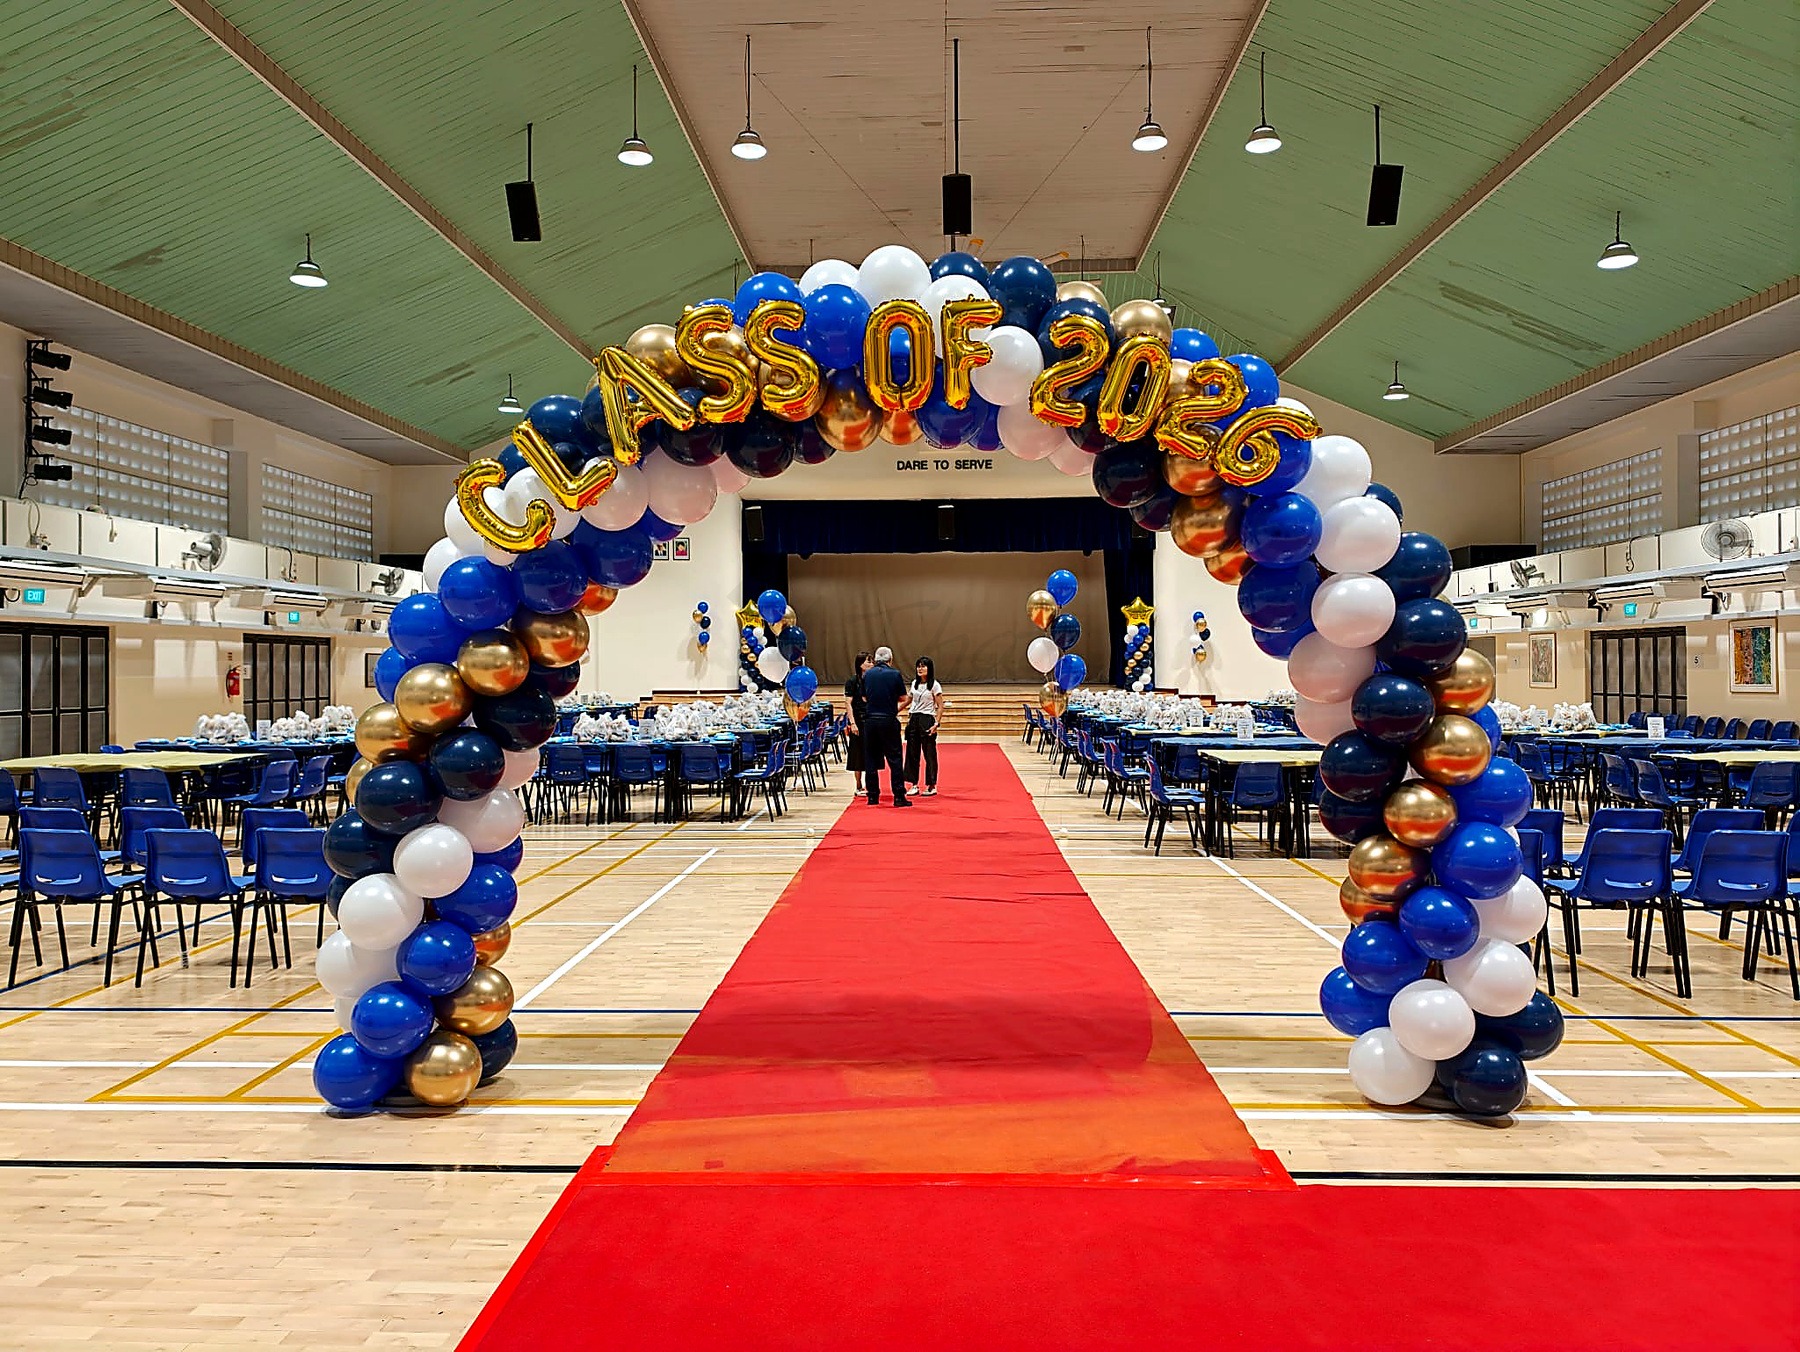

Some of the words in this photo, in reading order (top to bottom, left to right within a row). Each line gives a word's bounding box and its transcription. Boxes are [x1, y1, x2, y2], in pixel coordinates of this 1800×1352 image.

[456, 299, 820, 553] CLASS
[863, 297, 1004, 412] OF
[1029, 314, 1323, 486] 2026
[897, 460, 928, 470] DARE
[933, 460, 950, 470] TO
[955, 460, 993, 470] SERVE
[27, 590, 42, 601] EXIT
